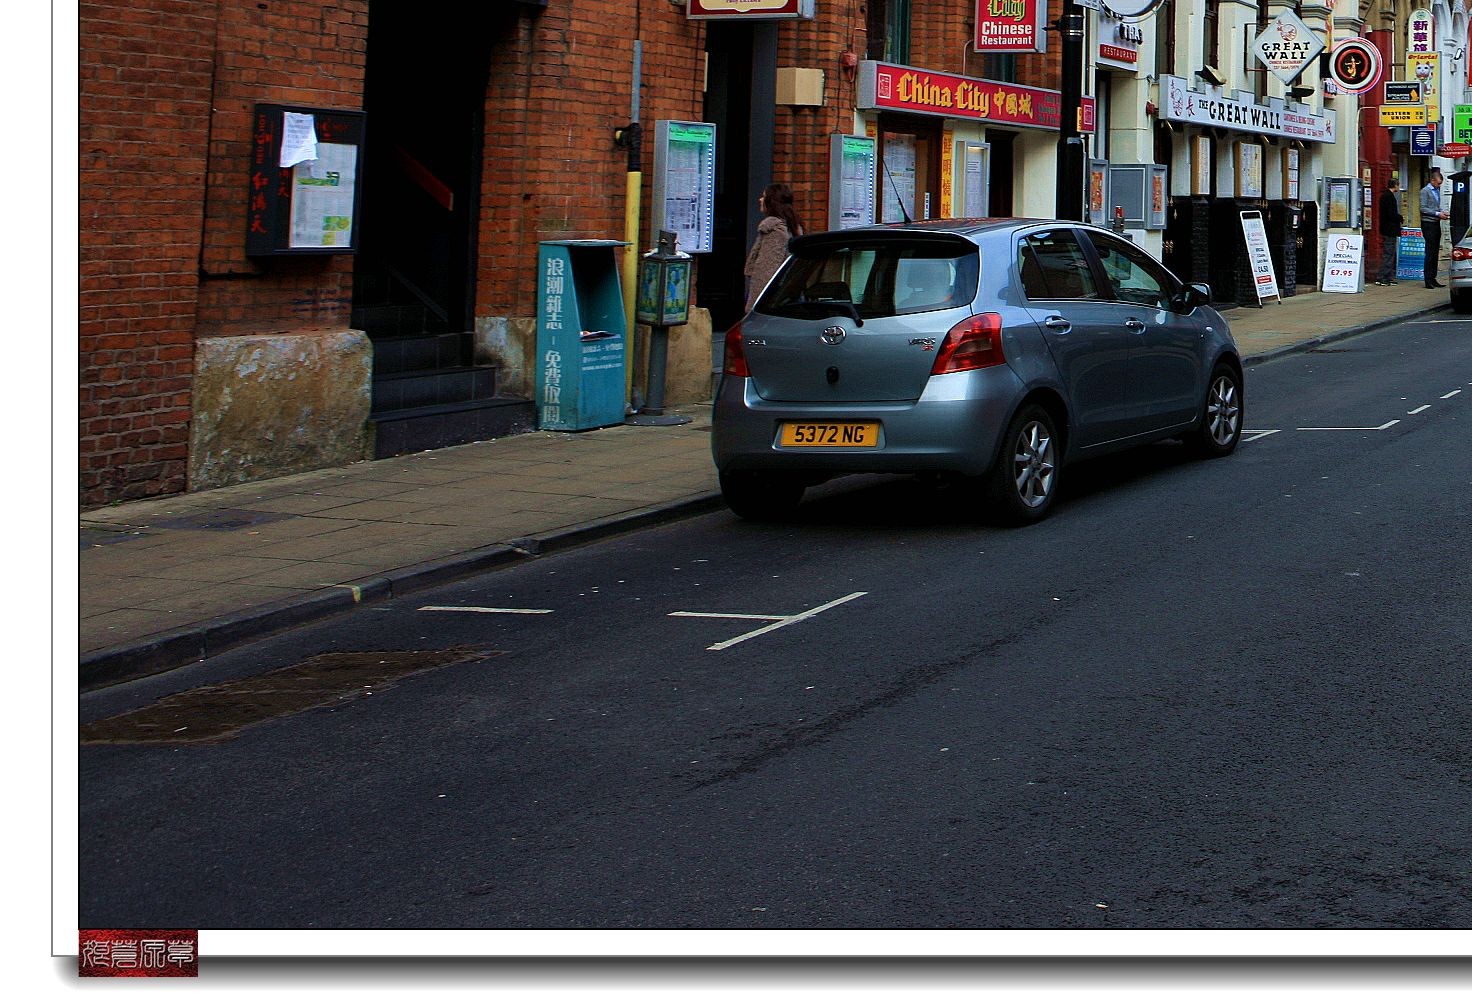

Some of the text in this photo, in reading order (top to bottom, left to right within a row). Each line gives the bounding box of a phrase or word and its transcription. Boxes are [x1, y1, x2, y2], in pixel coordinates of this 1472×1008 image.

[981, 21, 1033, 35] Chinese
[981, 36, 1033, 45] Restaurant
[1261, 42, 1311, 51] GREAT
[1264, 51, 1307, 60] WALL
[896, 71, 953, 111] China
[955, 81, 991, 118] City
[993, 87, 1034, 120] 中國城
[1199, 99, 1281, 130] THE GREAT WALL
[1457, 183, 1465, 191] P
[1330, 269, 1353, 277] £7.95
[794, 425, 865, 443] 5372 NG
